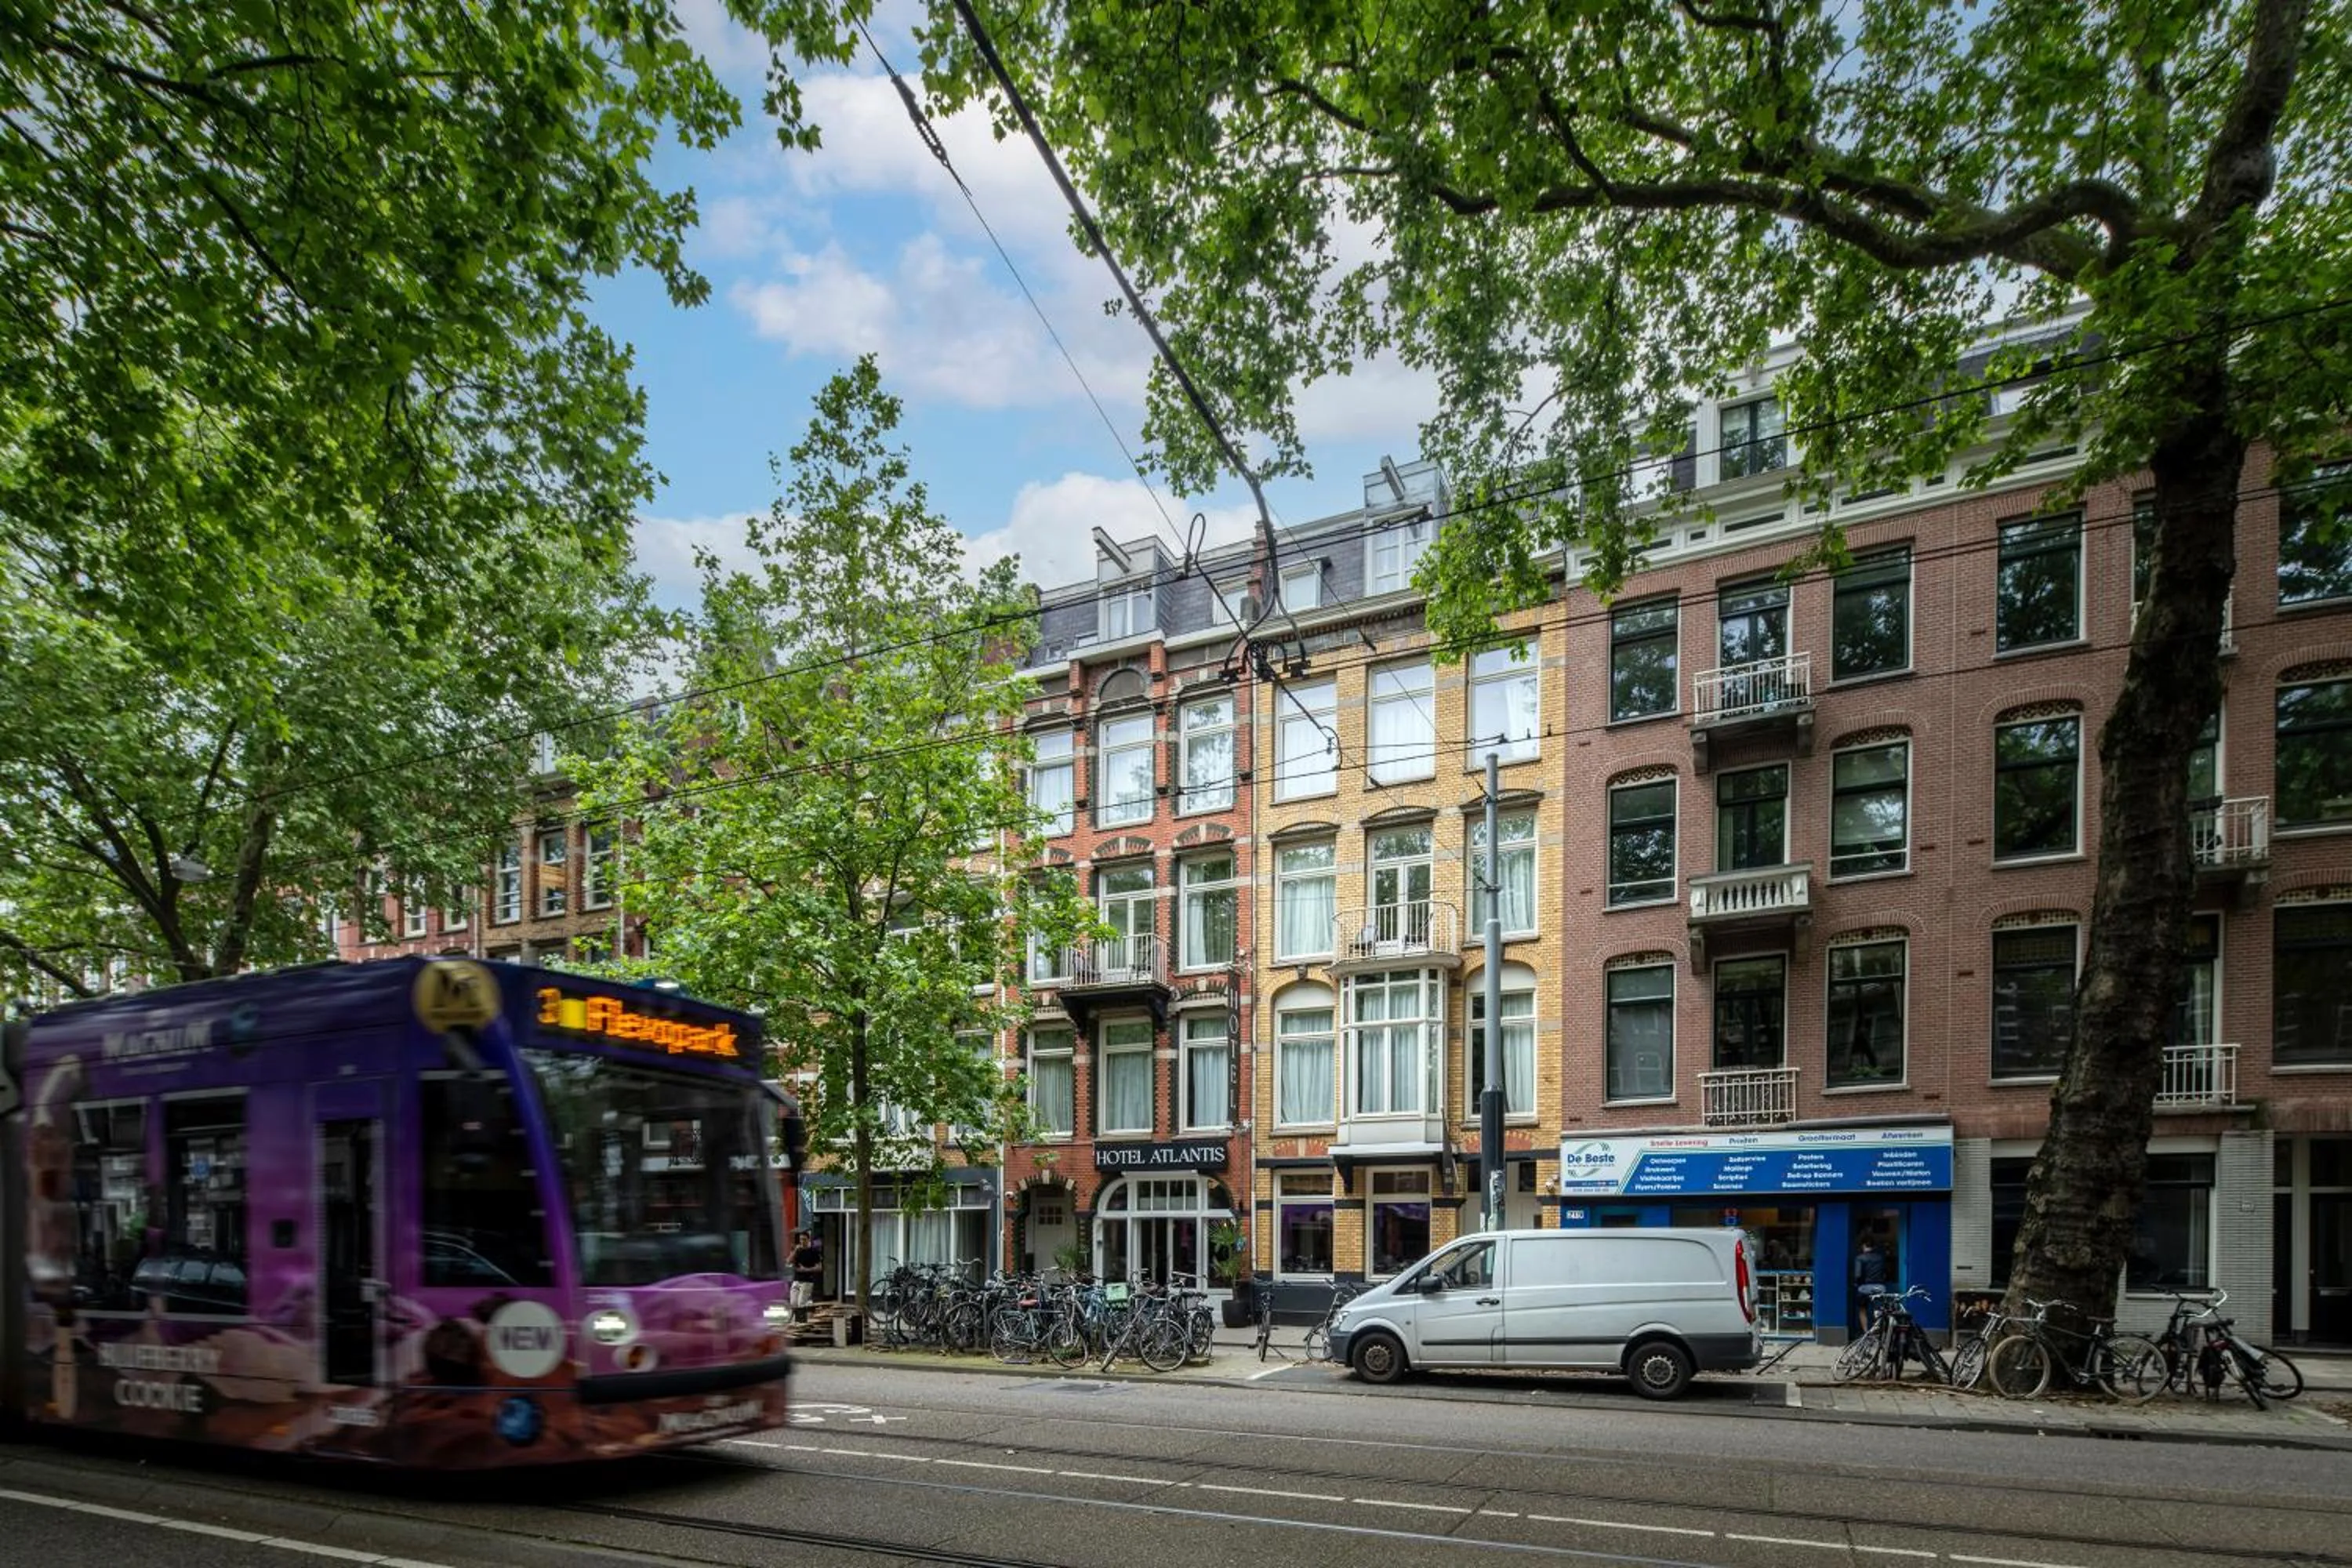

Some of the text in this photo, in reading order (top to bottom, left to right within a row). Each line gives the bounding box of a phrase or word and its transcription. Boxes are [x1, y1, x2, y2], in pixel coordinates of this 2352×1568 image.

[536, 987, 561, 1024] 3
[1229, 988, 1240, 1109] HOTEL
[1097, 1146, 1225, 1166] HOTEL ATLANTIS
[1567, 1153, 1616, 1163] De Beste
